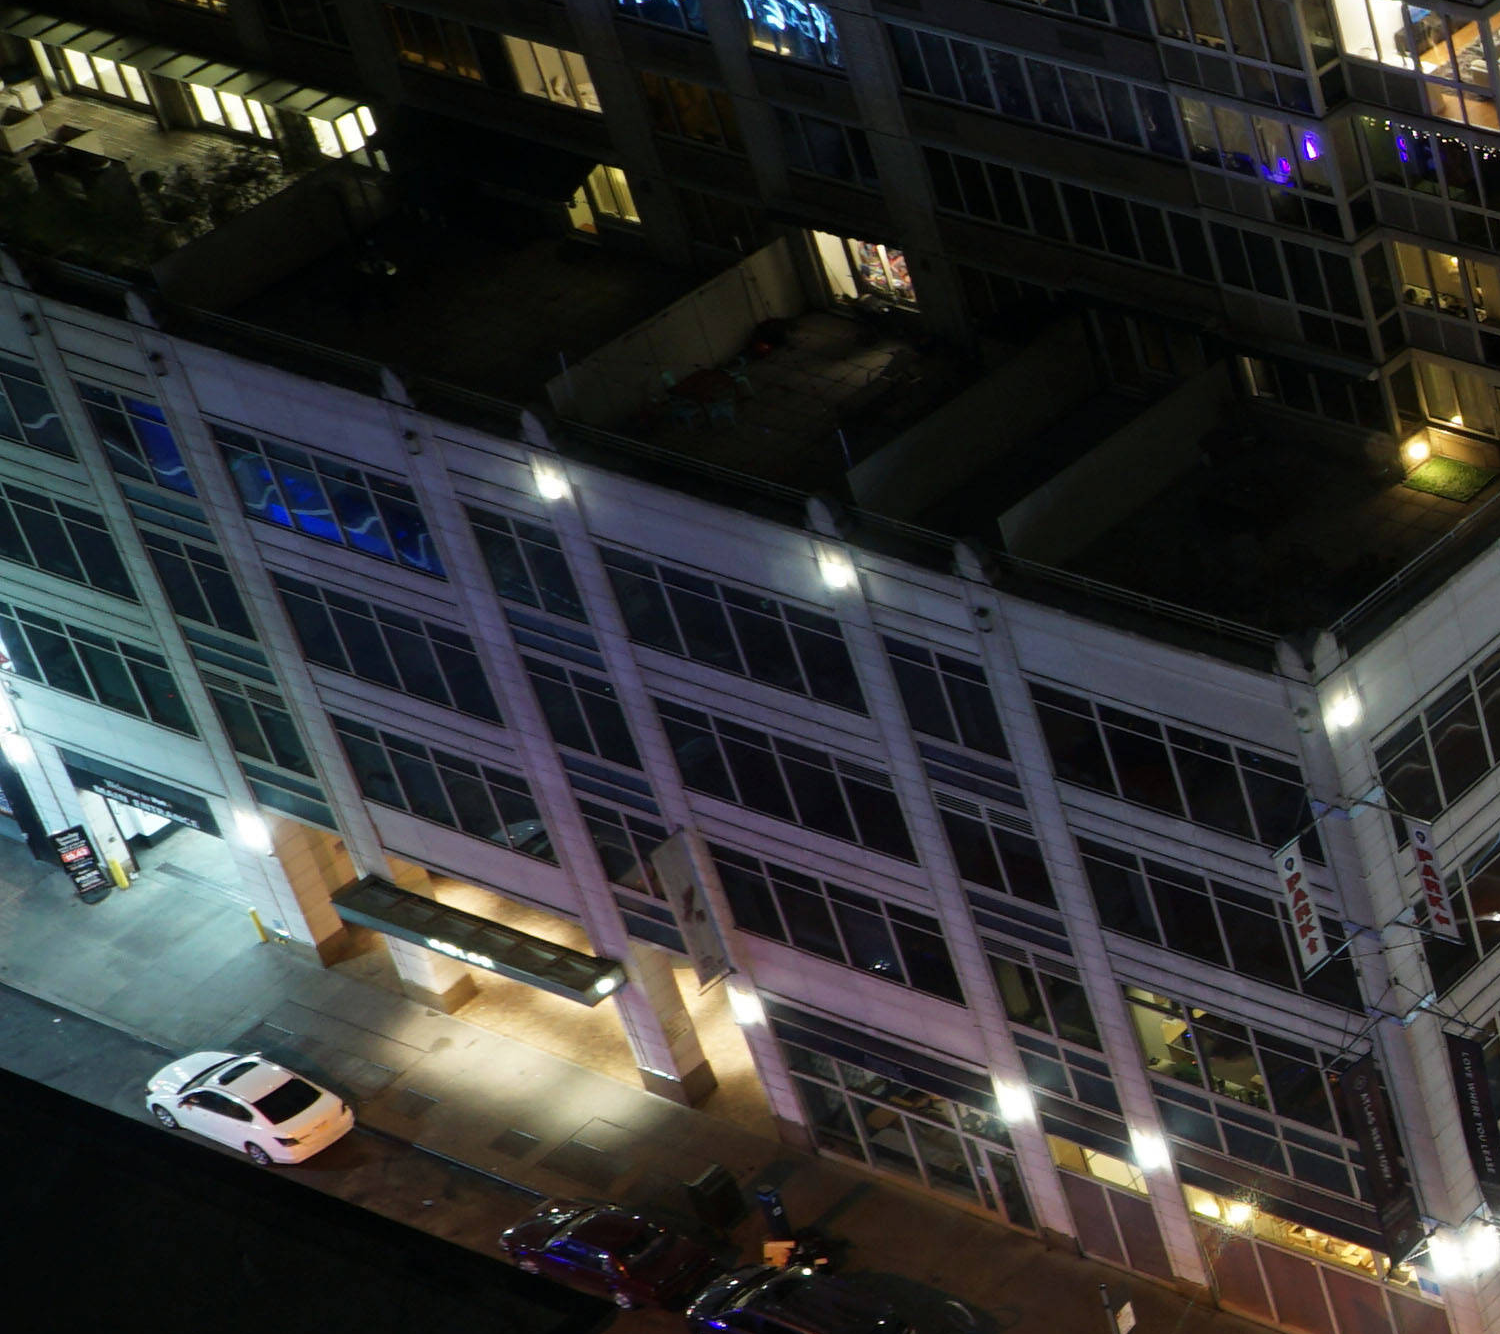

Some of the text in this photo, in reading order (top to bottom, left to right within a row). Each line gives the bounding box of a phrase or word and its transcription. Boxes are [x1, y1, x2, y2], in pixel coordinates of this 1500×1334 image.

[1286, 872, 1317, 940] PARK
[1416, 848, 1447, 912] PARK
[1461, 1051, 1473, 1085] LOVE
[1467, 1083, 1482, 1119] WHERE
